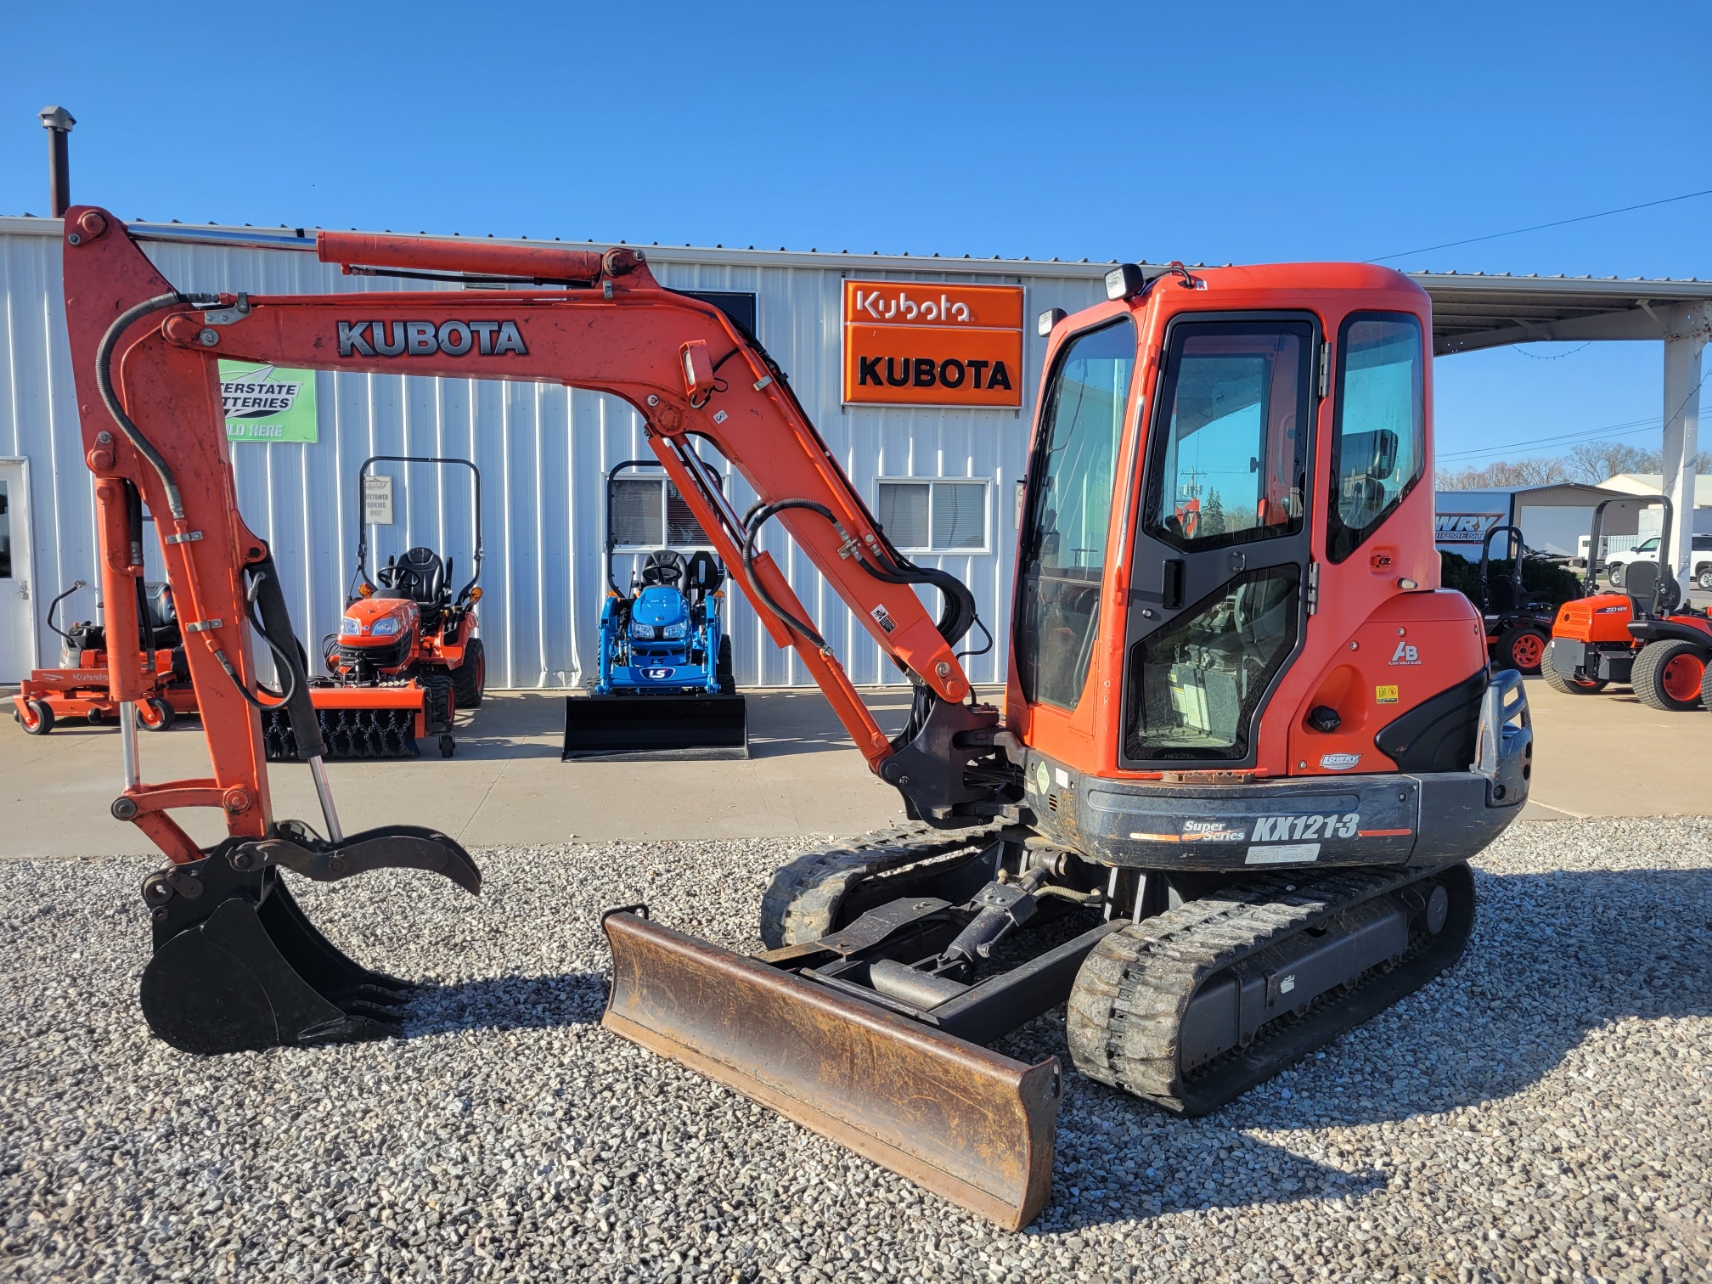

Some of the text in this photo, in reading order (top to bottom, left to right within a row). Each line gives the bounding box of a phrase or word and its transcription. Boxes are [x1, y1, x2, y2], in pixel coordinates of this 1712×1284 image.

[857, 291, 970, 321] Kubota
[337, 319, 529, 357] KUBOTA
[858, 356, 1012, 390] KUBOTA
[249, 424, 283, 437] HERE
[72, 673, 109, 681] Kubota
[649, 670, 666, 678] LS
[1322, 756, 1358, 764] LOWRY
[1184, 820, 1226, 832] Super
[1250, 813, 1360, 842] KX121-3
[1203, 830, 1245, 841] Series
